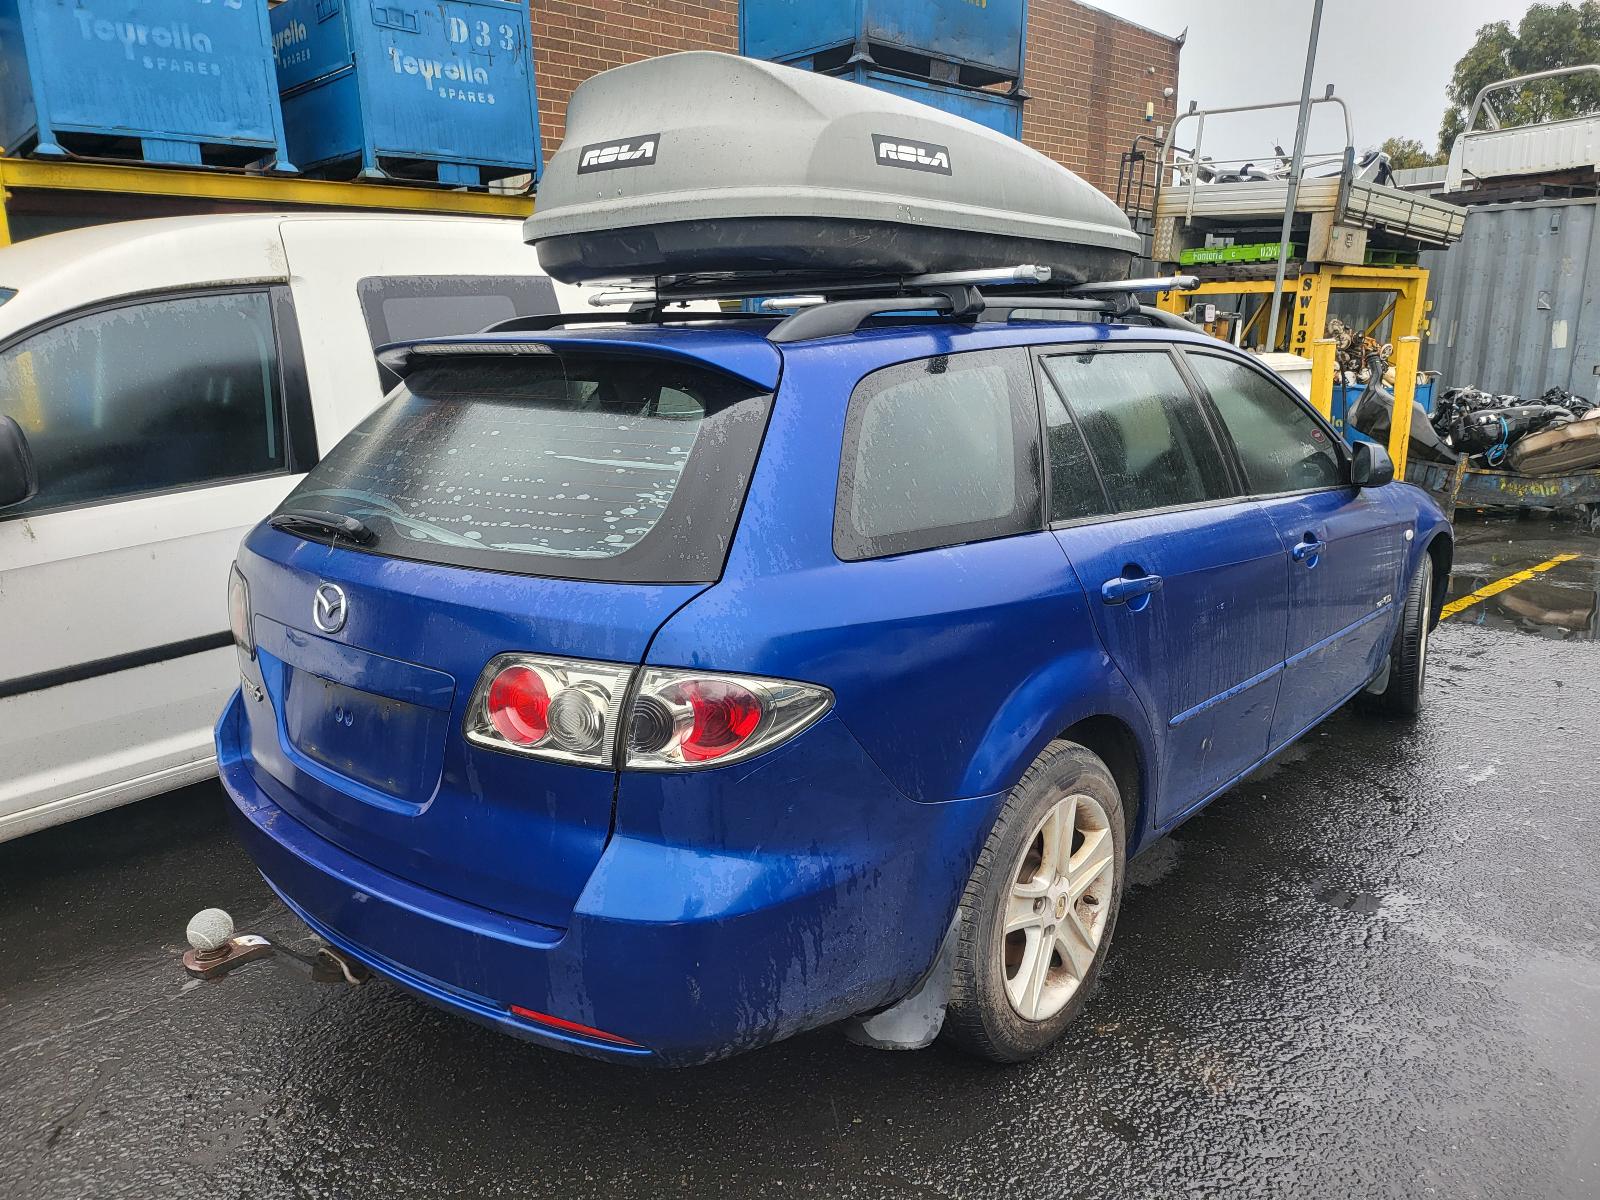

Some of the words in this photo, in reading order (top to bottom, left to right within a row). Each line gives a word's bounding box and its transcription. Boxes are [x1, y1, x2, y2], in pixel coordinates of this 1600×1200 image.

[271, 19, 307, 66] yrolla
[142, 55, 221, 76] SPARES
[438, 86, 496, 105] SPARES
[581, 140, 655, 167] ROLA
[879, 142, 949, 168] ROLA
